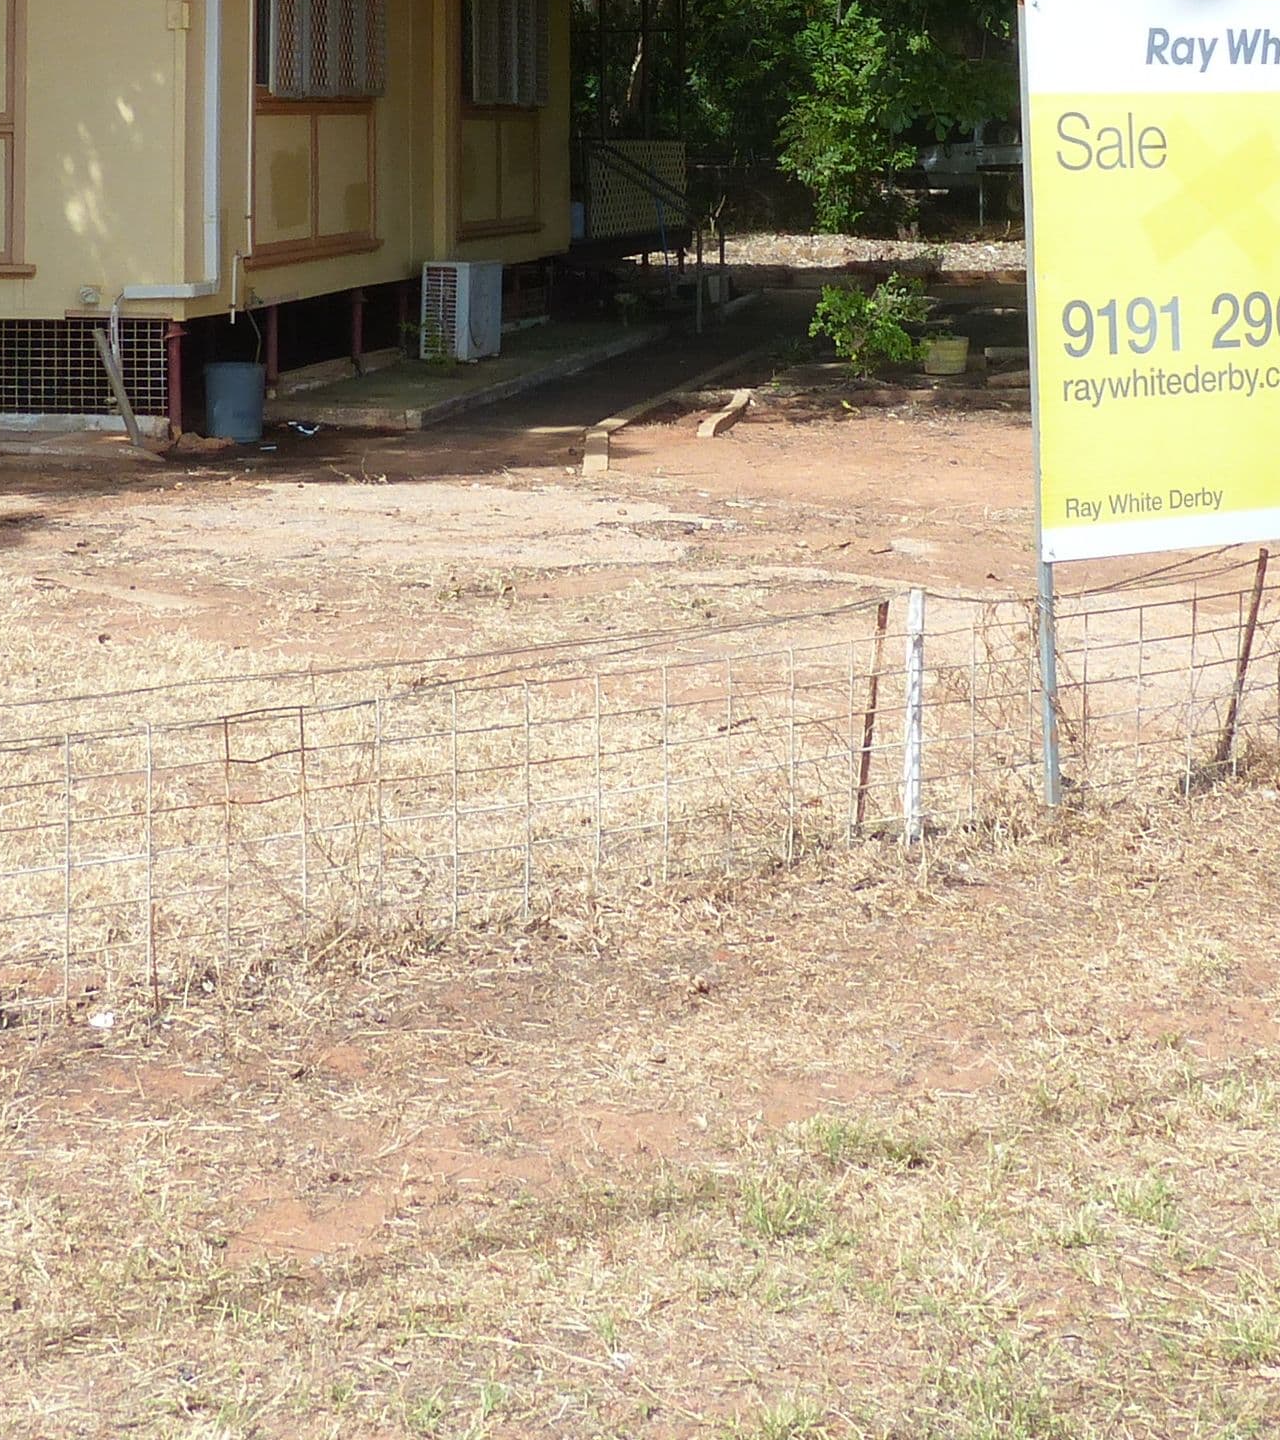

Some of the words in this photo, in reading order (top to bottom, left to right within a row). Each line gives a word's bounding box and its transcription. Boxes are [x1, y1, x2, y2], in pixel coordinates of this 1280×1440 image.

[1145, 27, 1218, 72] Ray
[1056, 112, 1168, 171] Sale
[1061, 295, 1182, 358] 9191
[1065, 496, 1102, 520] Ray
[1109, 492, 1162, 513] White
[1169, 487, 1223, 510] Derby
